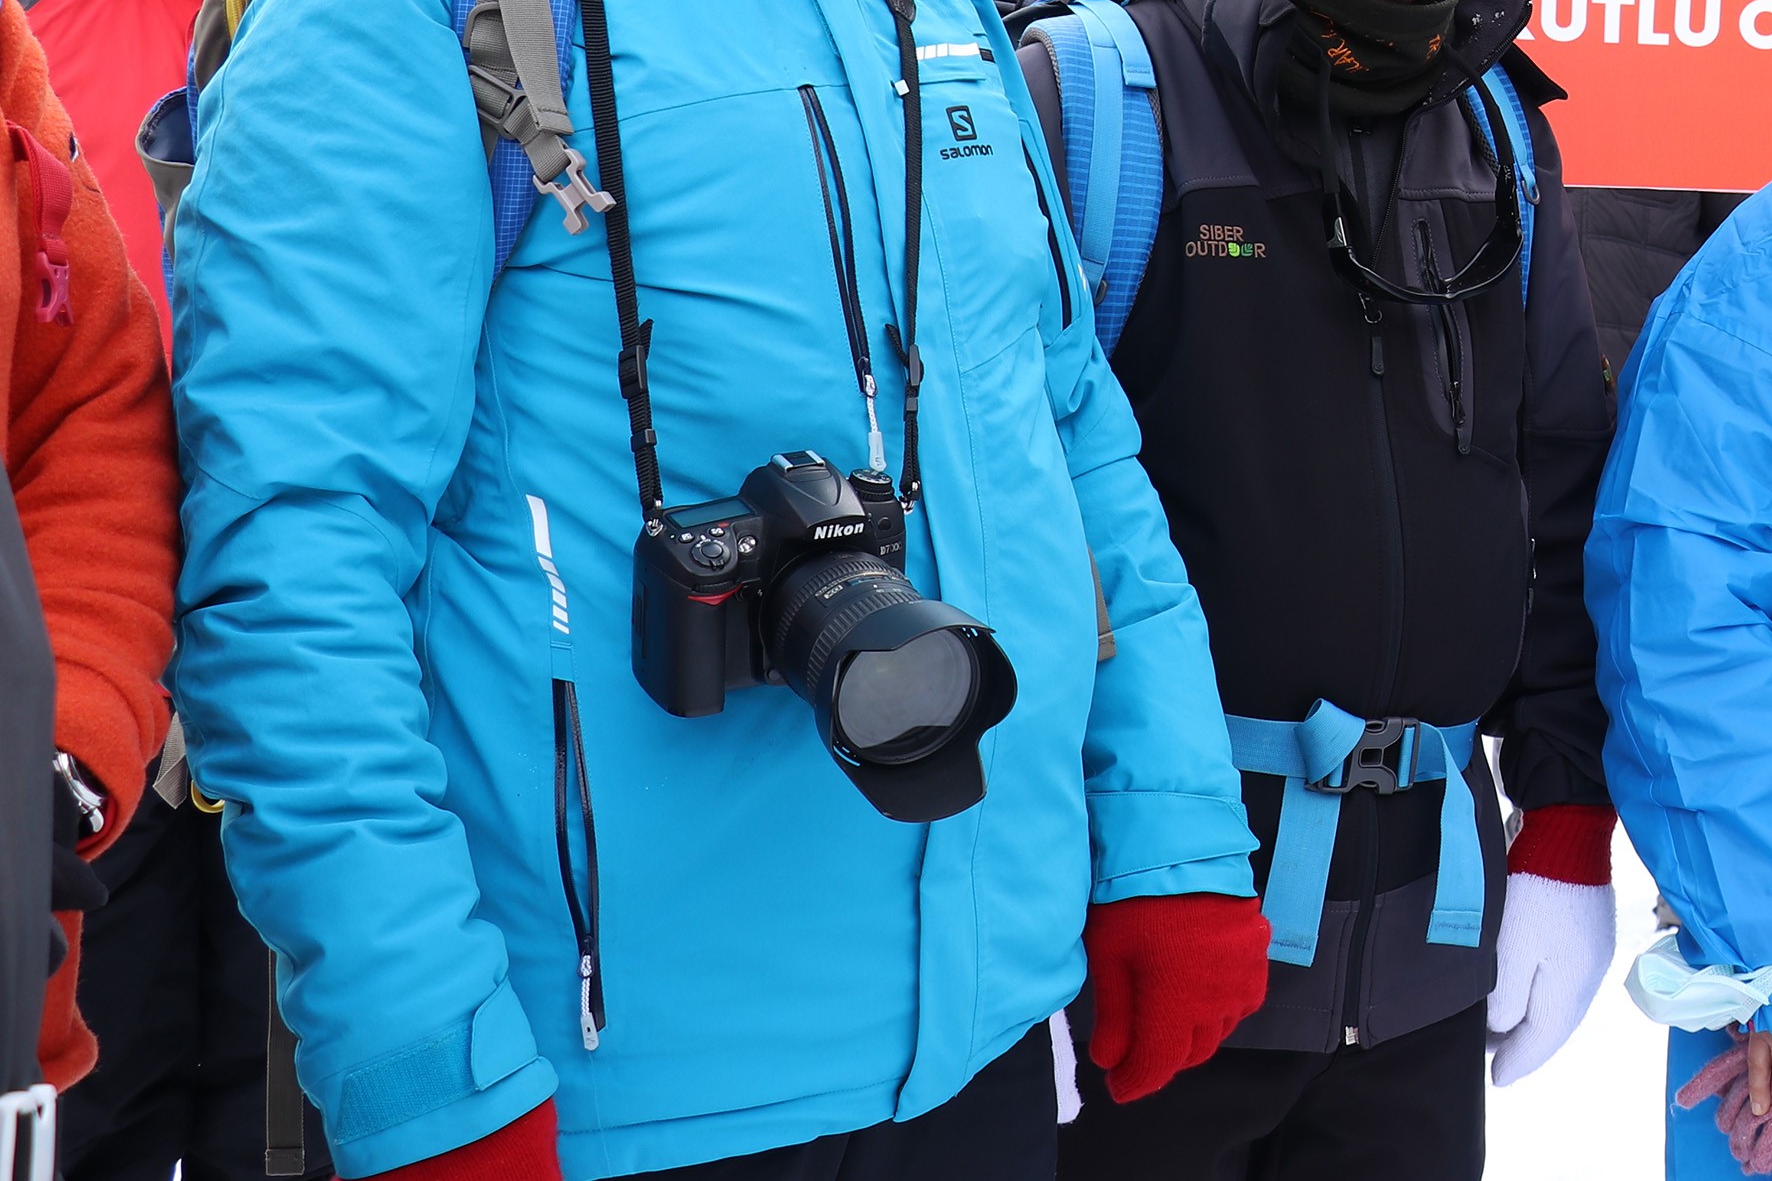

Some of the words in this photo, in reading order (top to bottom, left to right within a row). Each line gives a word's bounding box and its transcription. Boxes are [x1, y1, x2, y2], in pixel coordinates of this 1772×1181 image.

[1199, 224, 1244, 242] SIBER
[1185, 241, 1267, 258] OUTDOOR
[813, 522, 865, 540] Nikon
